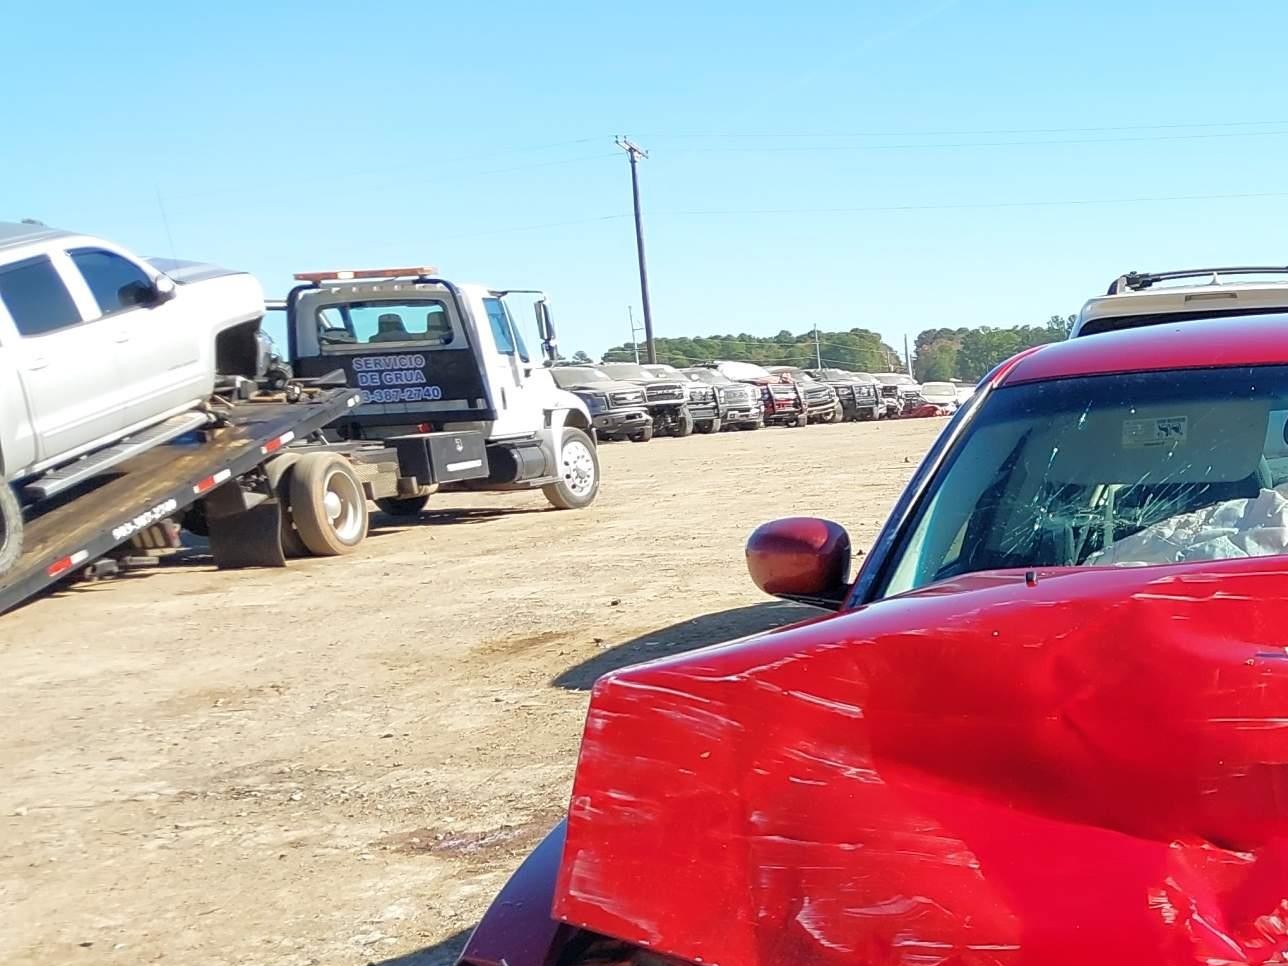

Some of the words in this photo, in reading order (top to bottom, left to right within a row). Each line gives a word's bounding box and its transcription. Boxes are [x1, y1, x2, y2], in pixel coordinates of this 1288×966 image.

[353, 354, 425, 371] SERVICIO
[358, 372, 380, 386] DE
[382, 370, 426, 385] GRUA
[361, 386, 441, 403] 3-387-2740
